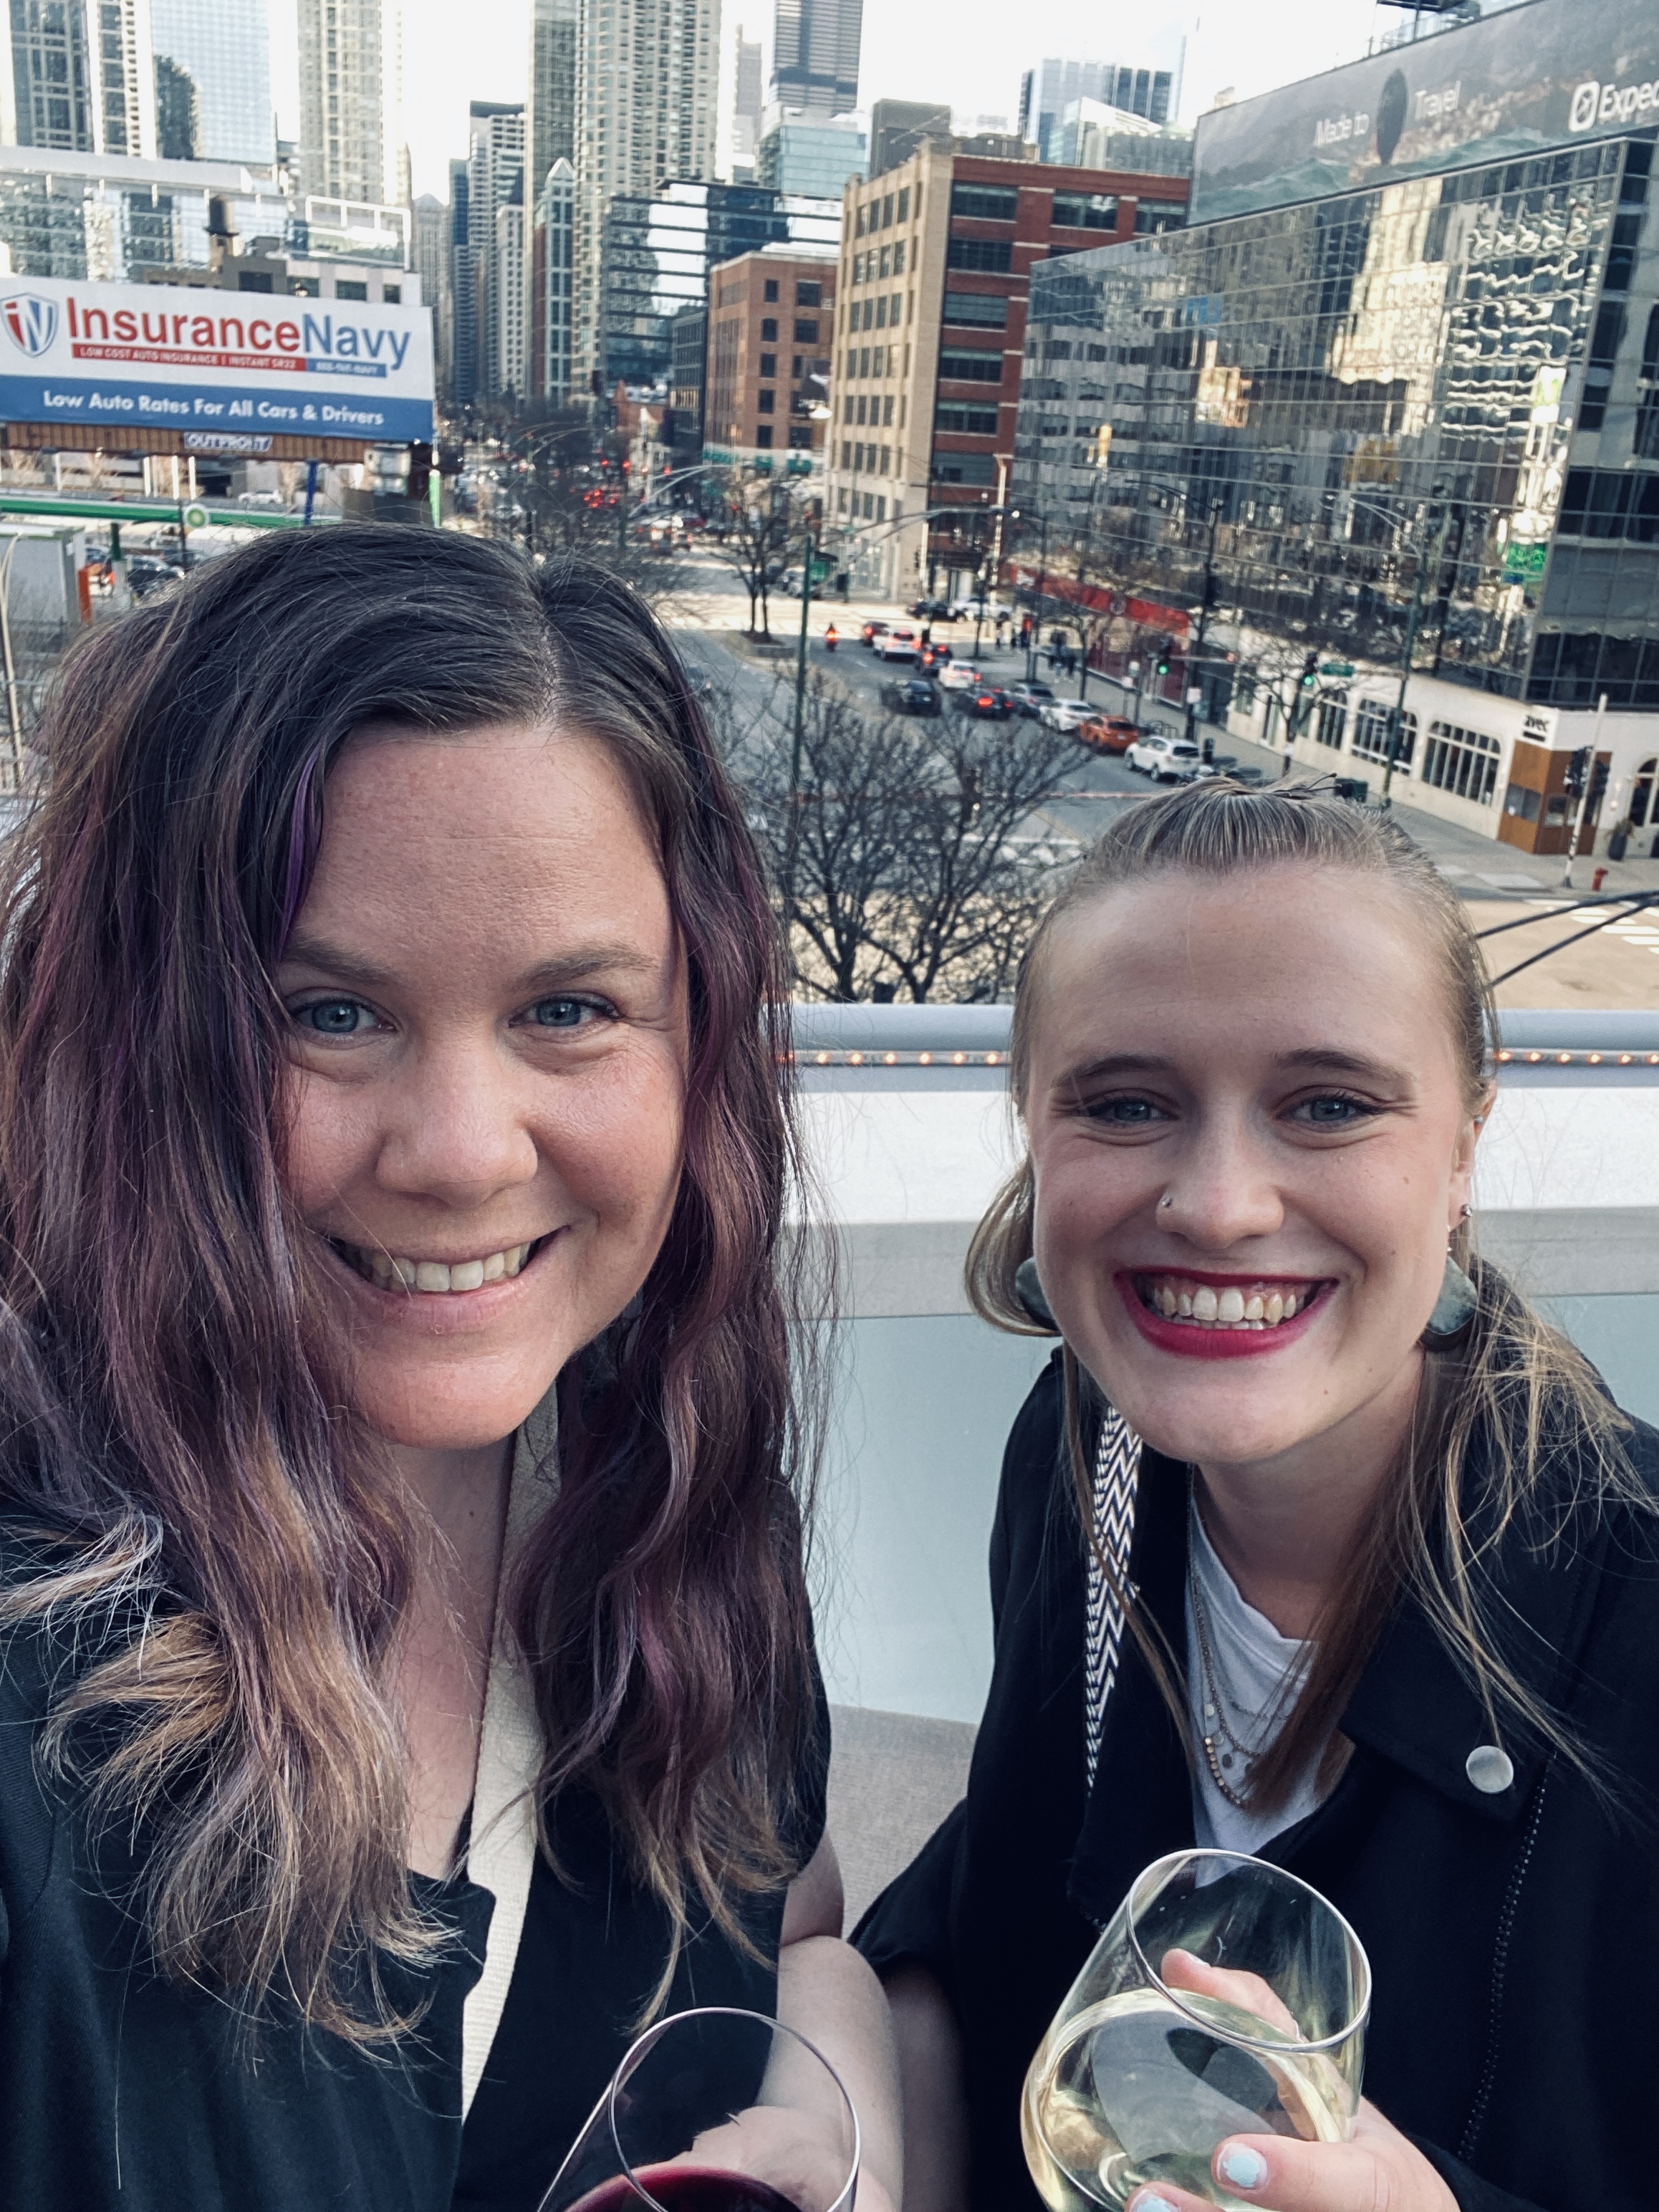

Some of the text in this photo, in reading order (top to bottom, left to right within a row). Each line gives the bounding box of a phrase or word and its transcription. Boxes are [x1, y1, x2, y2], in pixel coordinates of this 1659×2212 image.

[1314, 80, 1461, 147] Made to Travel
[66, 297, 410, 370] InsuranceNavy
[80, 347, 102, 357] LOW
[105, 348, 132, 359] COST
[133, 350, 159, 361] AUTO
[160, 351, 219, 365] INSURANCE
[44, 390, 384, 425] Low Auto Rates For All Cars & Drivers
[187, 433, 269, 451] OUTFRONT
